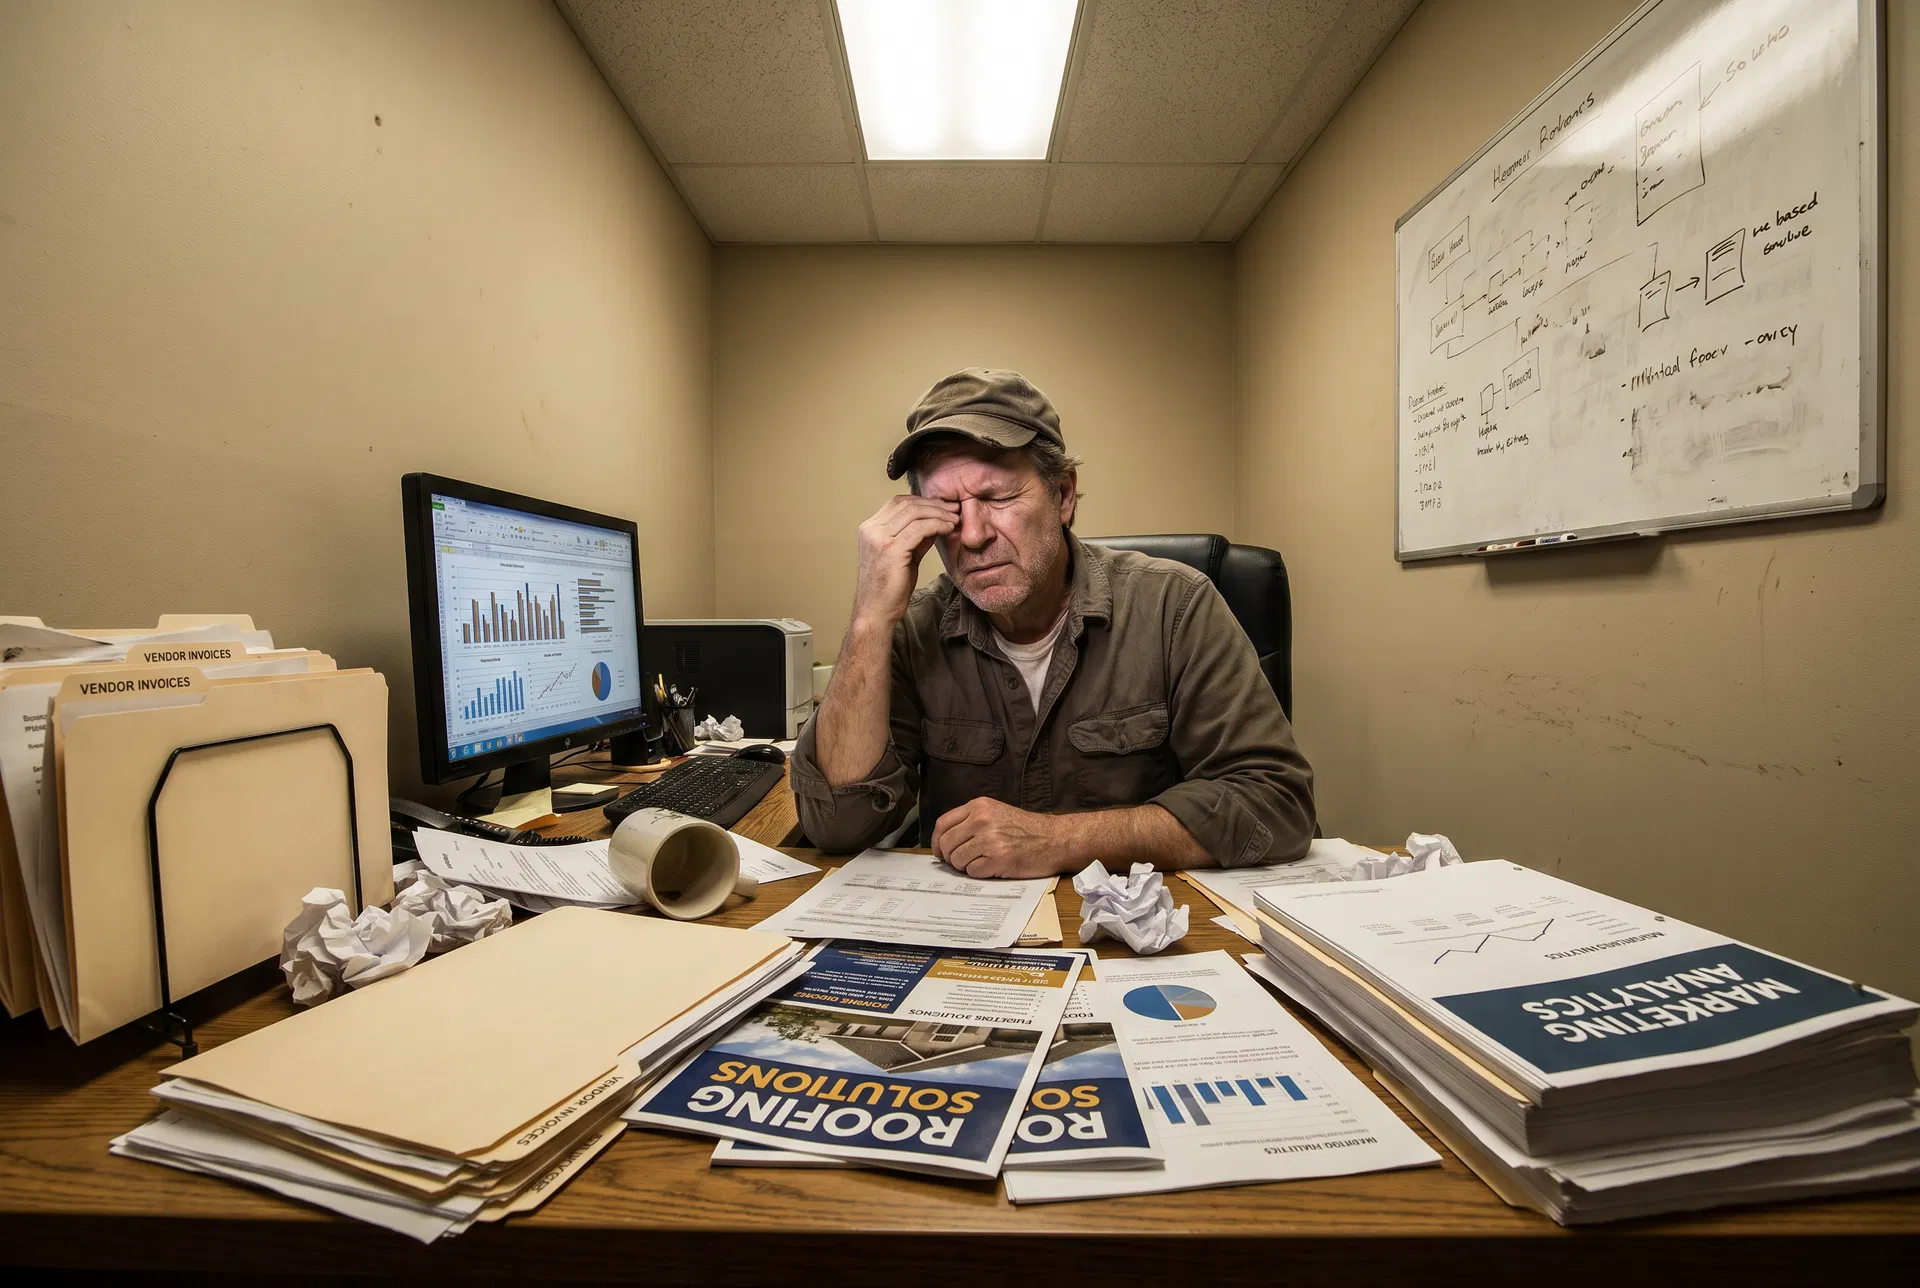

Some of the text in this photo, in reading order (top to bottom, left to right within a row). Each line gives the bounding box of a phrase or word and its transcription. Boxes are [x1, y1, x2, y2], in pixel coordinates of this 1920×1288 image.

[1776, 190, 1818, 227] based
[143, 649, 232, 663] VENDOR INVOICES
[79, 676, 191, 695] VENDOR INVOICES
[1521, 963, 1744, 1021] ANALYTICS
[1543, 977, 1802, 1043] MARKETING
[709, 1060, 981, 1115] SOLUTIONS
[1026, 1085, 1100, 1112] SO
[516, 1075, 624, 1147] VENDOR INVOICES
[686, 1084, 965, 1148] ROOFING
[1012, 1111, 1108, 1144] RO
